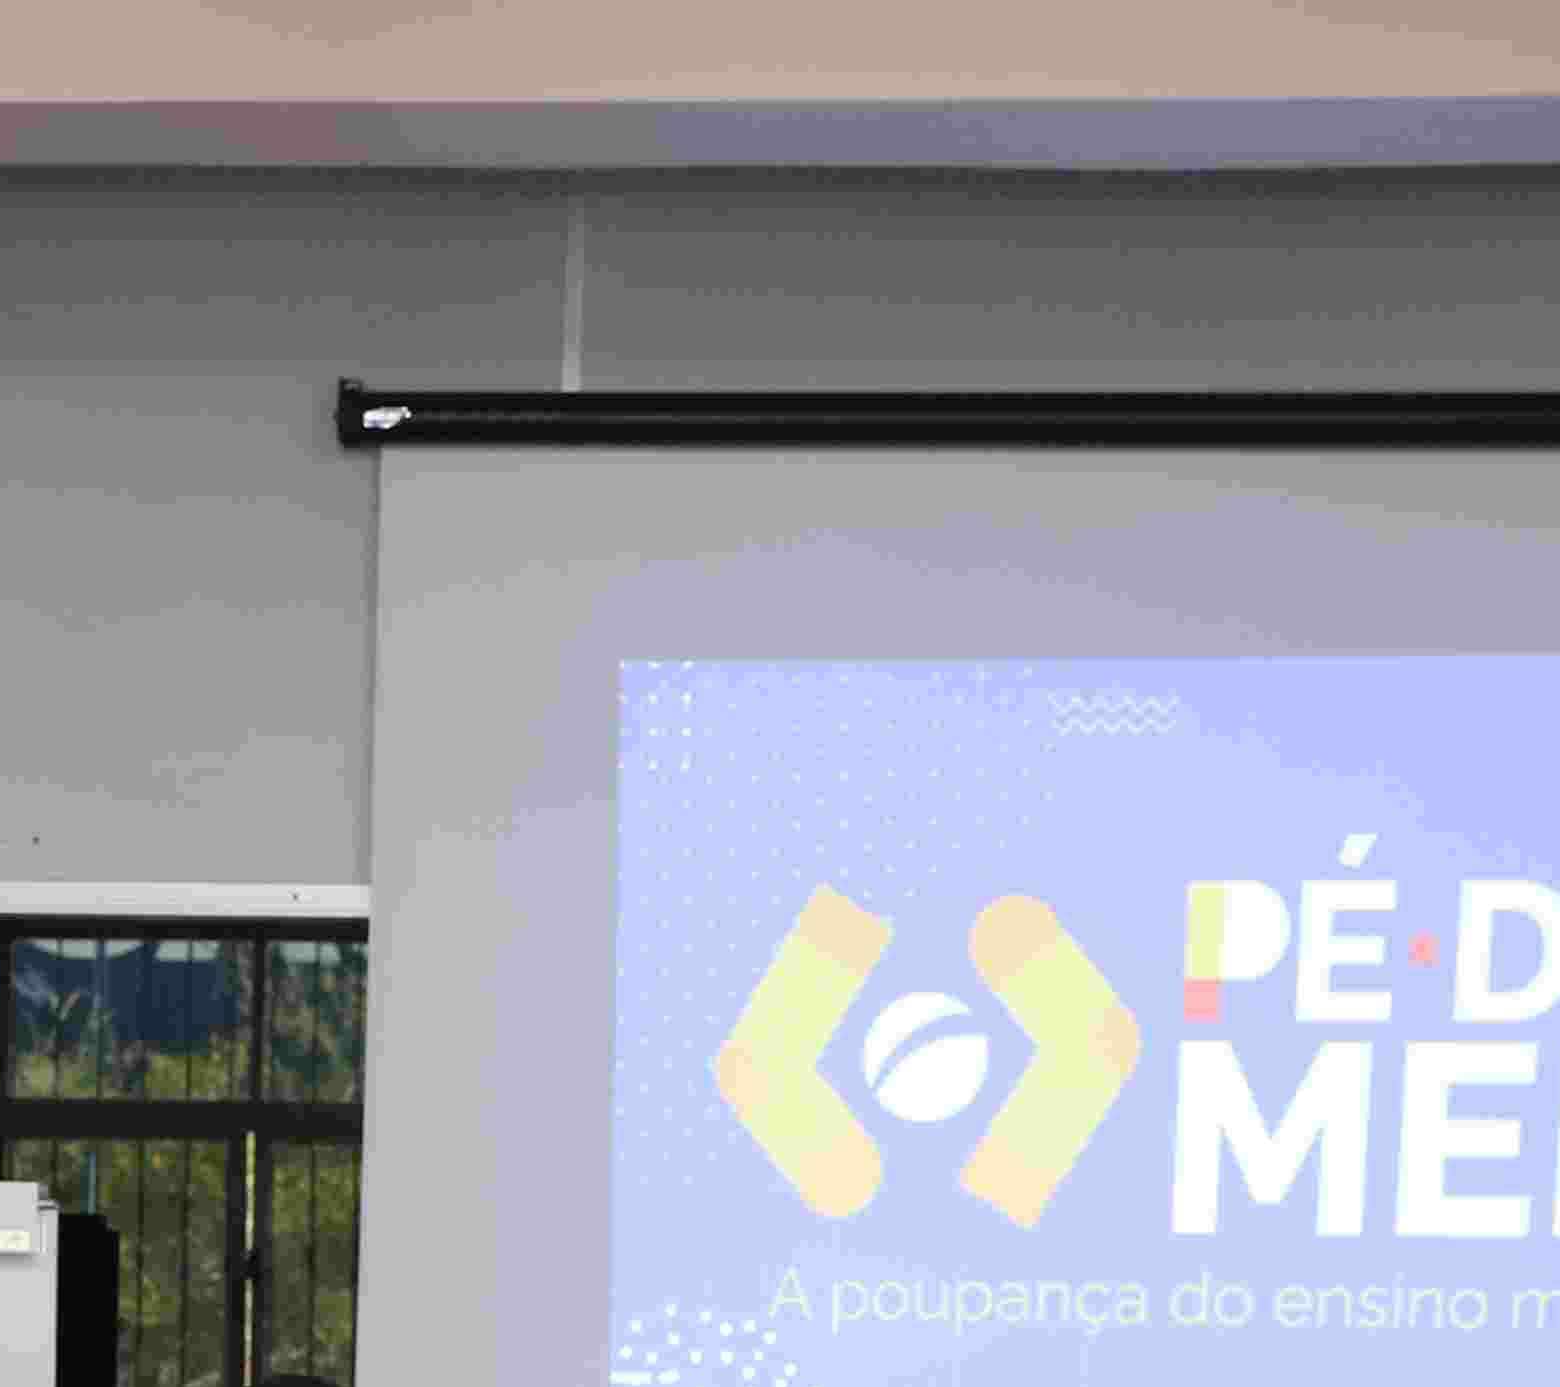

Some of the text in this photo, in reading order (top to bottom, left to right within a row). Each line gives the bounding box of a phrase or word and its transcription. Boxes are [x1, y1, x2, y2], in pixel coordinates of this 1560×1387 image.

[767, 1267, 813, 1323] A
[829, 1274, 1150, 1336] poupança
[1168, 1270, 1254, 1330] do
[1271, 1272, 1488, 1331] ensino
